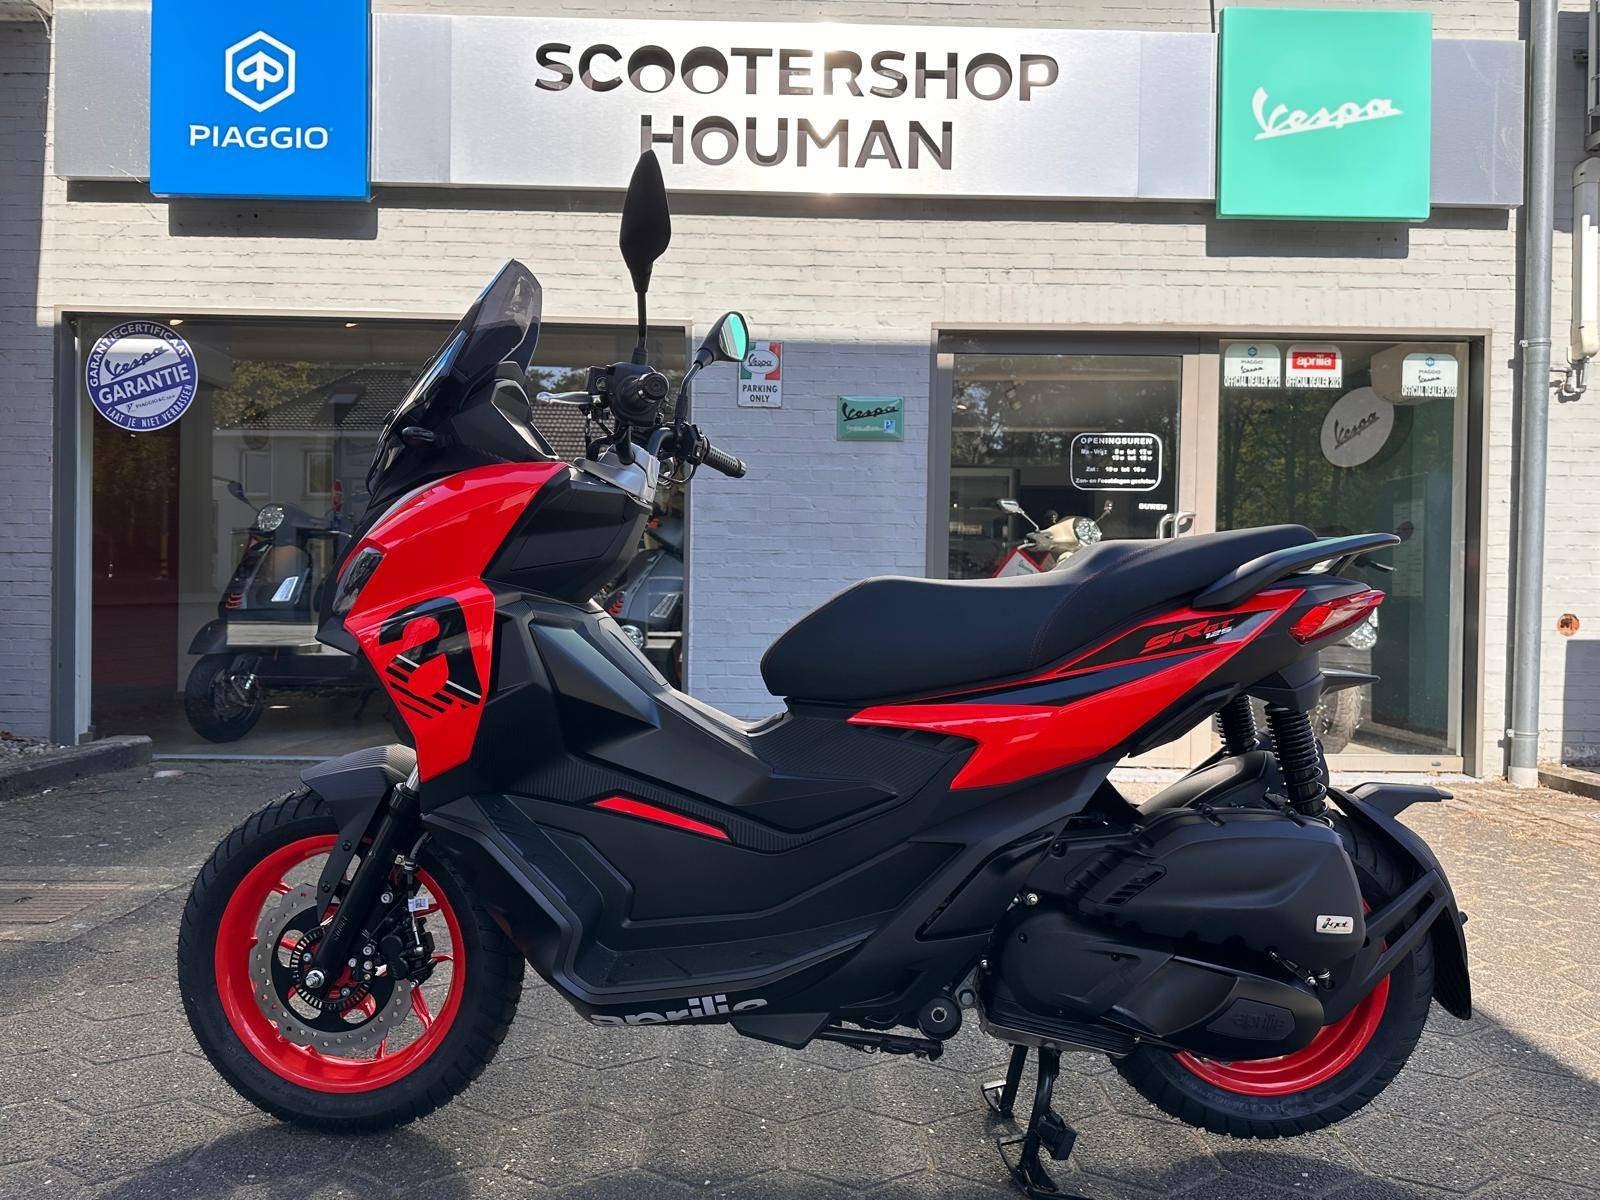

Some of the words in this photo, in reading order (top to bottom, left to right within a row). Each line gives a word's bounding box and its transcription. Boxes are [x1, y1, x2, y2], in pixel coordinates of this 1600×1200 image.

[534, 41, 1058, 101] SCOOTERSHOP
[1252, 86, 1404, 141] Vespa
[189, 124, 329, 150] PIAGGIO
[640, 114, 953, 170] HOUMAN
[89, 323, 190, 388] GARANTIECERTIFICAAT
[104, 346, 170, 381] Vespa
[747, 353, 774, 367] Vespa
[1296, 354, 1332, 368] aprilia
[98, 363, 191, 405] GARANTIE
[742, 384, 778, 393] PARKING
[750, 394, 770, 402] ONLY
[105, 407, 123, 423] LAAT
[141, 417, 161, 428] NIET
[161, 384, 193, 422] VERRASSEN
[841, 402, 899, 421] Vespa
[1080, 437, 1153, 445] OPENINGSUREN
[1334, 411, 1380, 450] Vespa
[1205, 626, 1233, 639] 125
